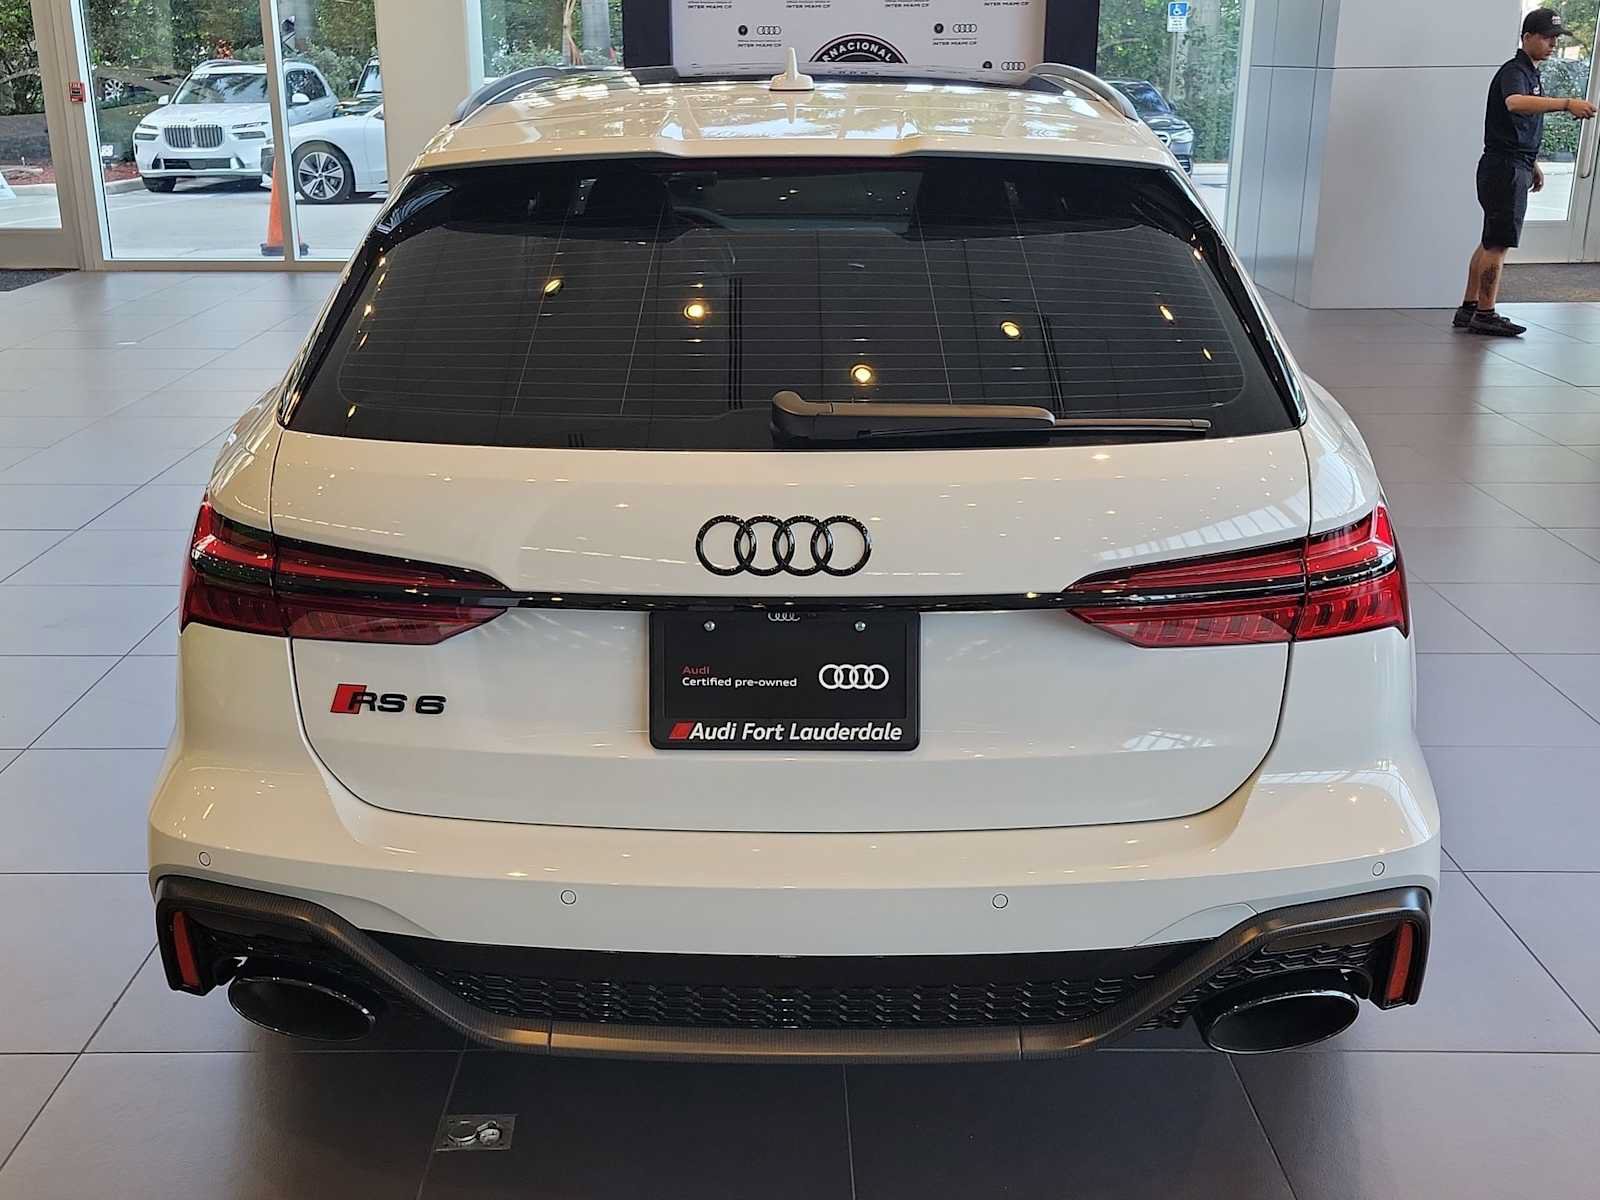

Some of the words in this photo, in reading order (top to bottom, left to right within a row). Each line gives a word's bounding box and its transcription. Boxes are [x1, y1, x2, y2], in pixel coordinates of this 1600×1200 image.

[682, 665, 710, 675] Audi
[682, 677, 732, 687] Certified
[735, 678, 797, 689] pre-owned
[348, 692, 408, 713] RS
[415, 695, 447, 715] 6
[689, 722, 737, 741] Audi
[742, 722, 784, 741] Fort
[790, 722, 903, 742] Lauderdale
